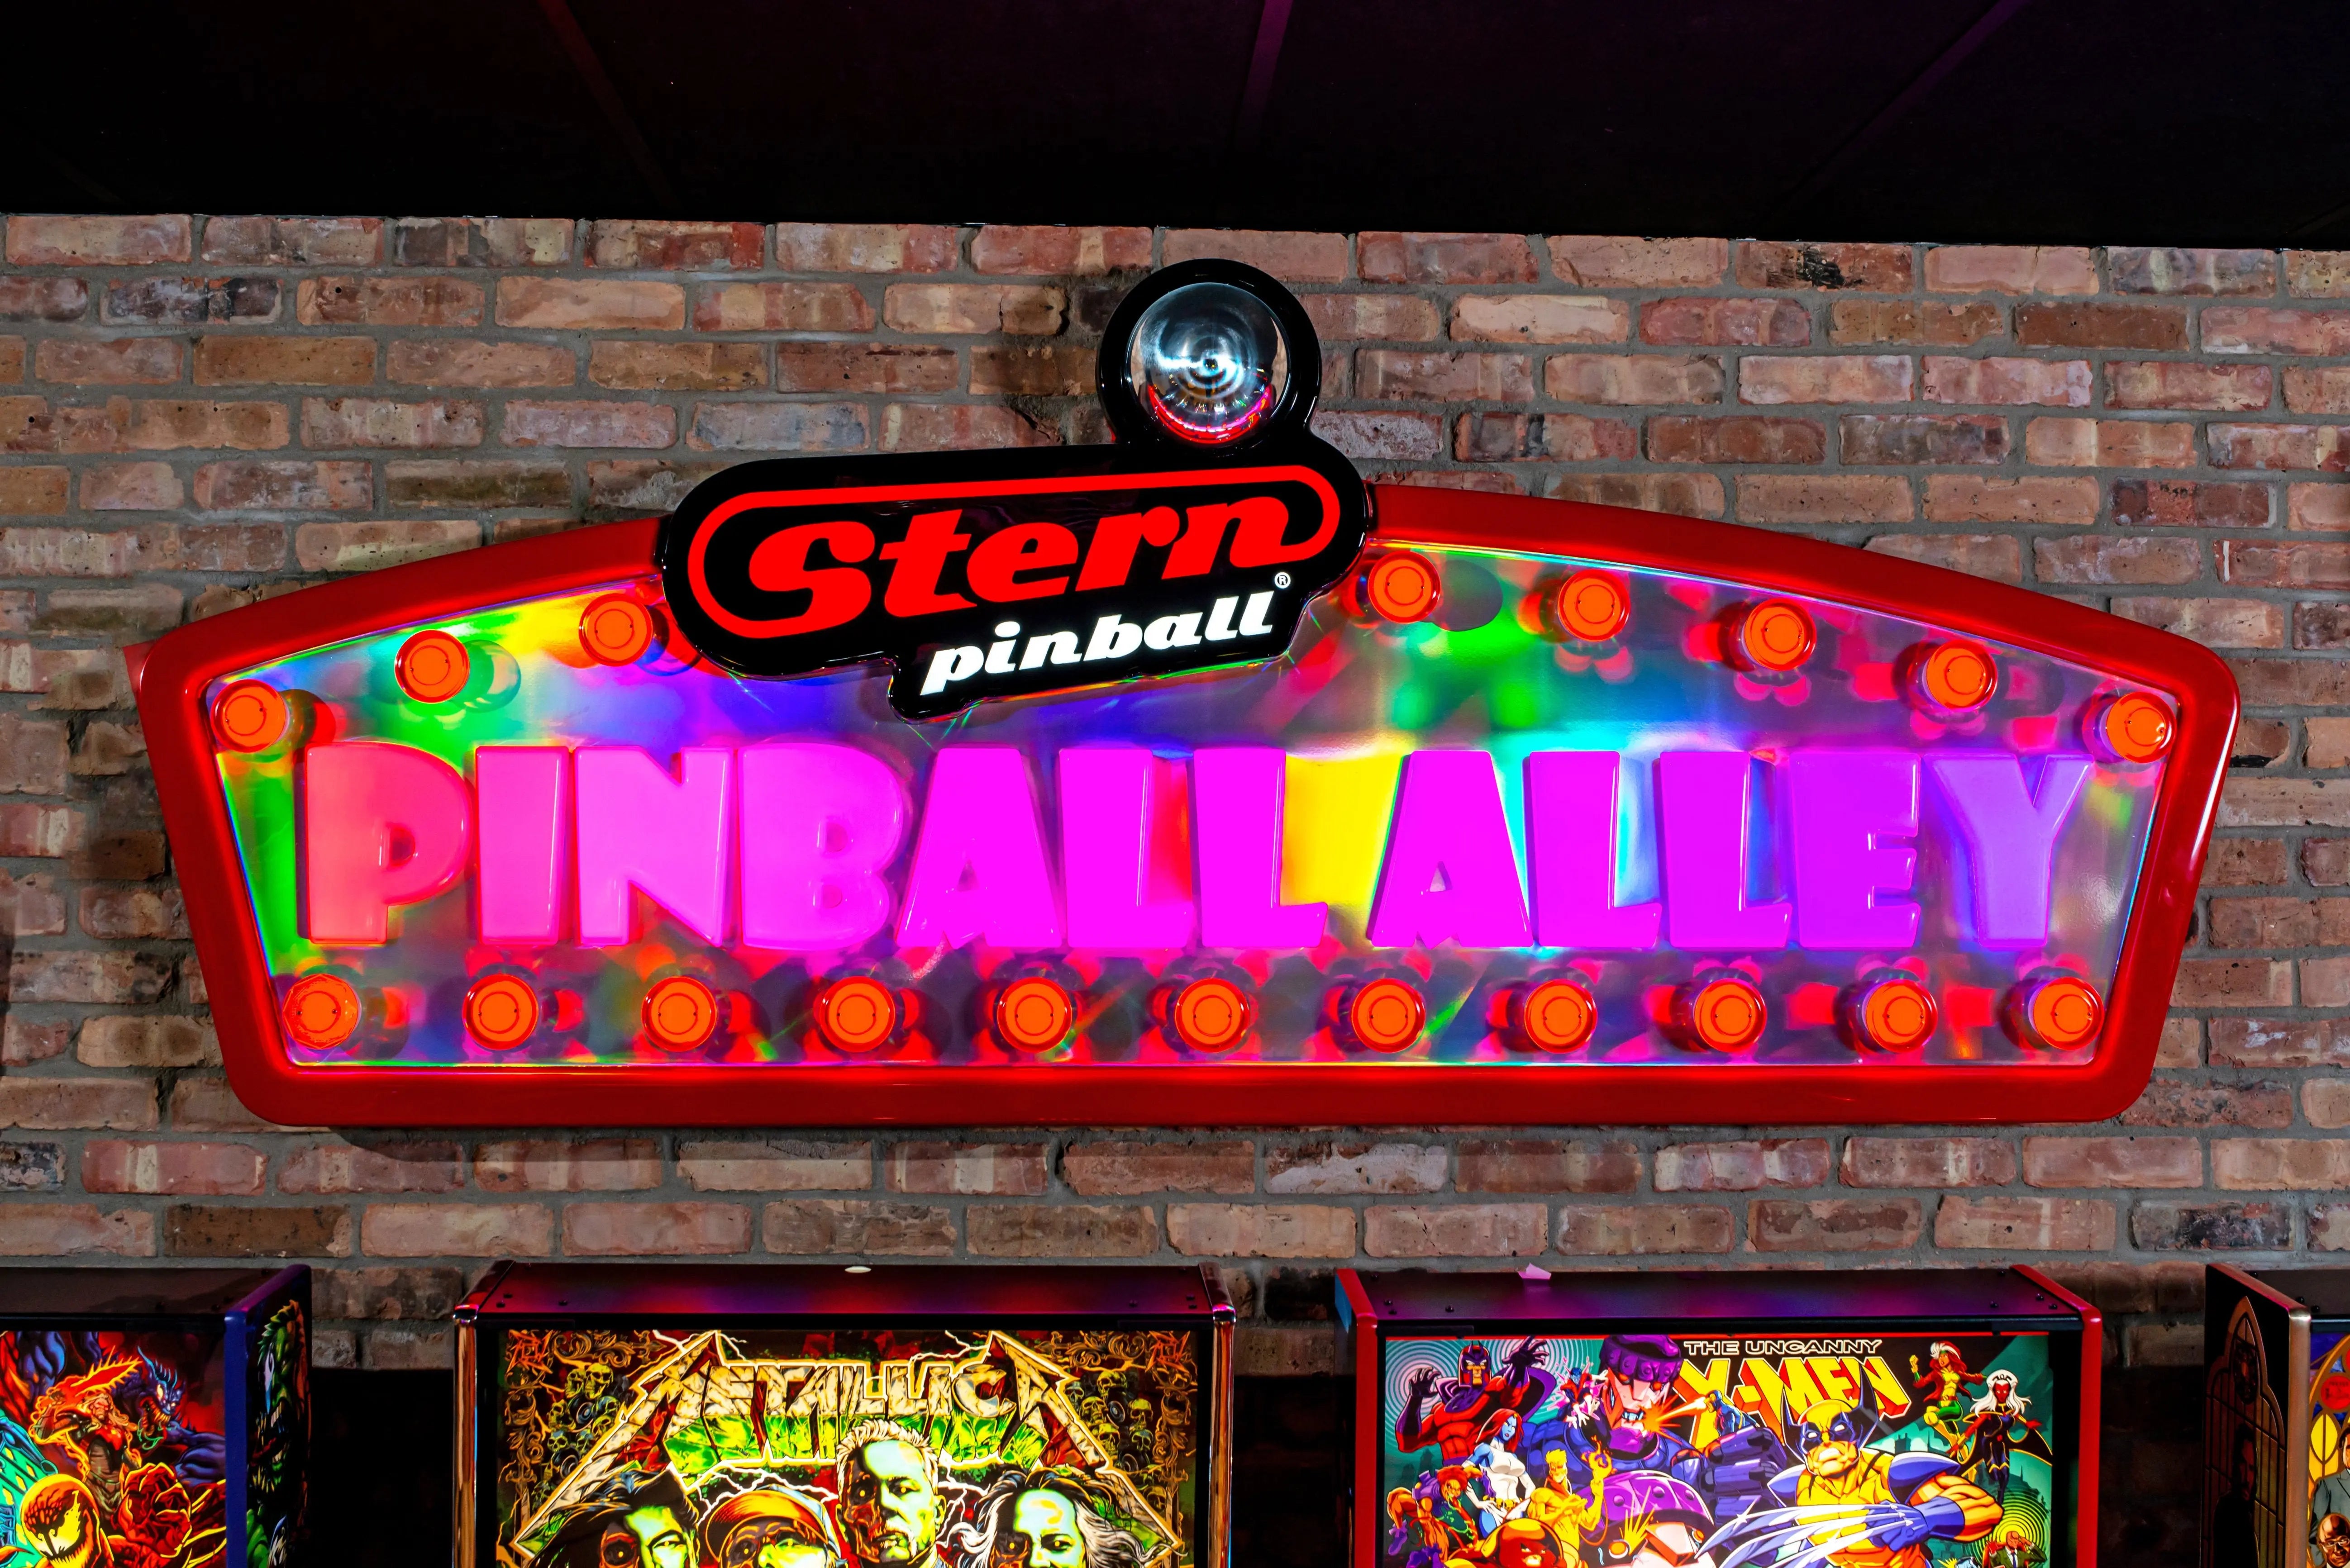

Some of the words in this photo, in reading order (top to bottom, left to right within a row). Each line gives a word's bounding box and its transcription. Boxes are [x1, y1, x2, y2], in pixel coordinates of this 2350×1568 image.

[740, 495, 1303, 638] Stern
[304, 741, 1329, 949] PINBALL
[1367, 749, 2094, 948] ALLEY
[1673, 1356, 1911, 1450] X-MEN
[1683, 1340, 1739, 1355] THE
[1745, 1339, 1883, 1355] UNCANNY
[512, 1331, 1180, 1556] METALLICA
